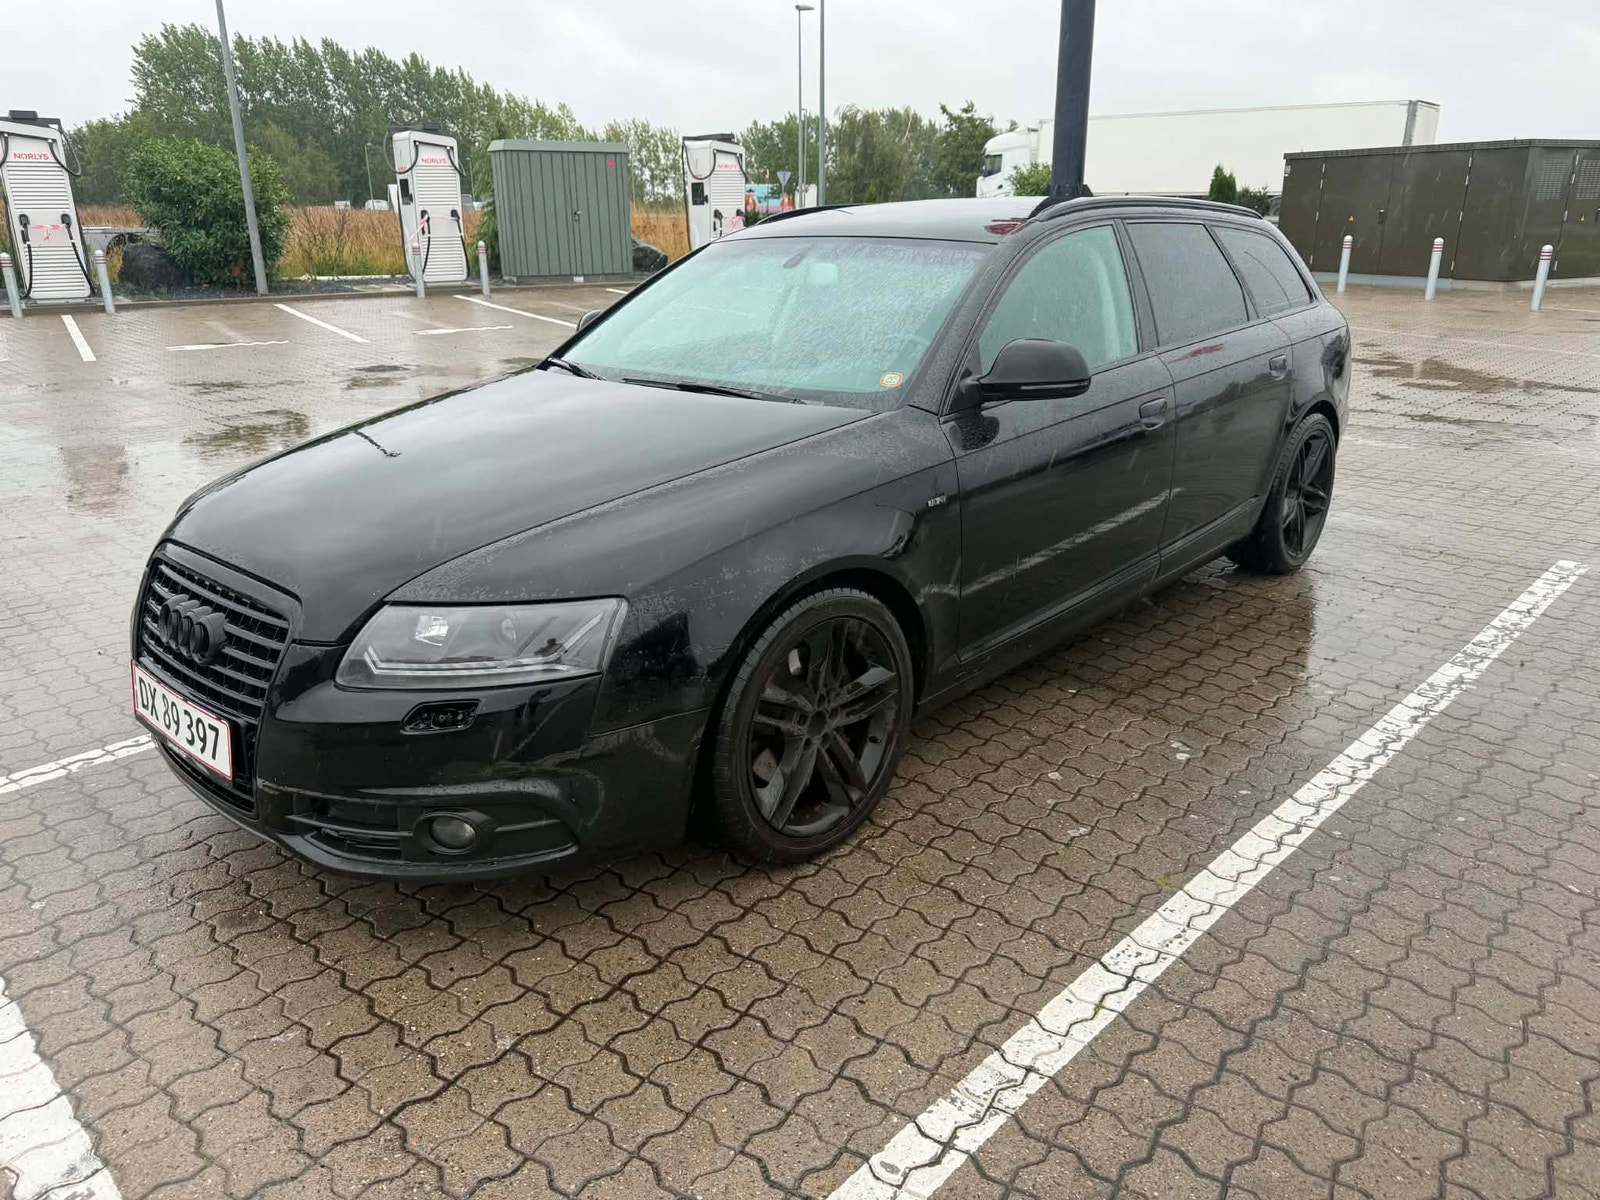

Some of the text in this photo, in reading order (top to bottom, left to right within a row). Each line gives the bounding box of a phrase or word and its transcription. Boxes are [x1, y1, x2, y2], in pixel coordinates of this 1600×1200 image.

[13, 152, 49, 160] NORLYS
[139, 676, 220, 761] DX 89 397
